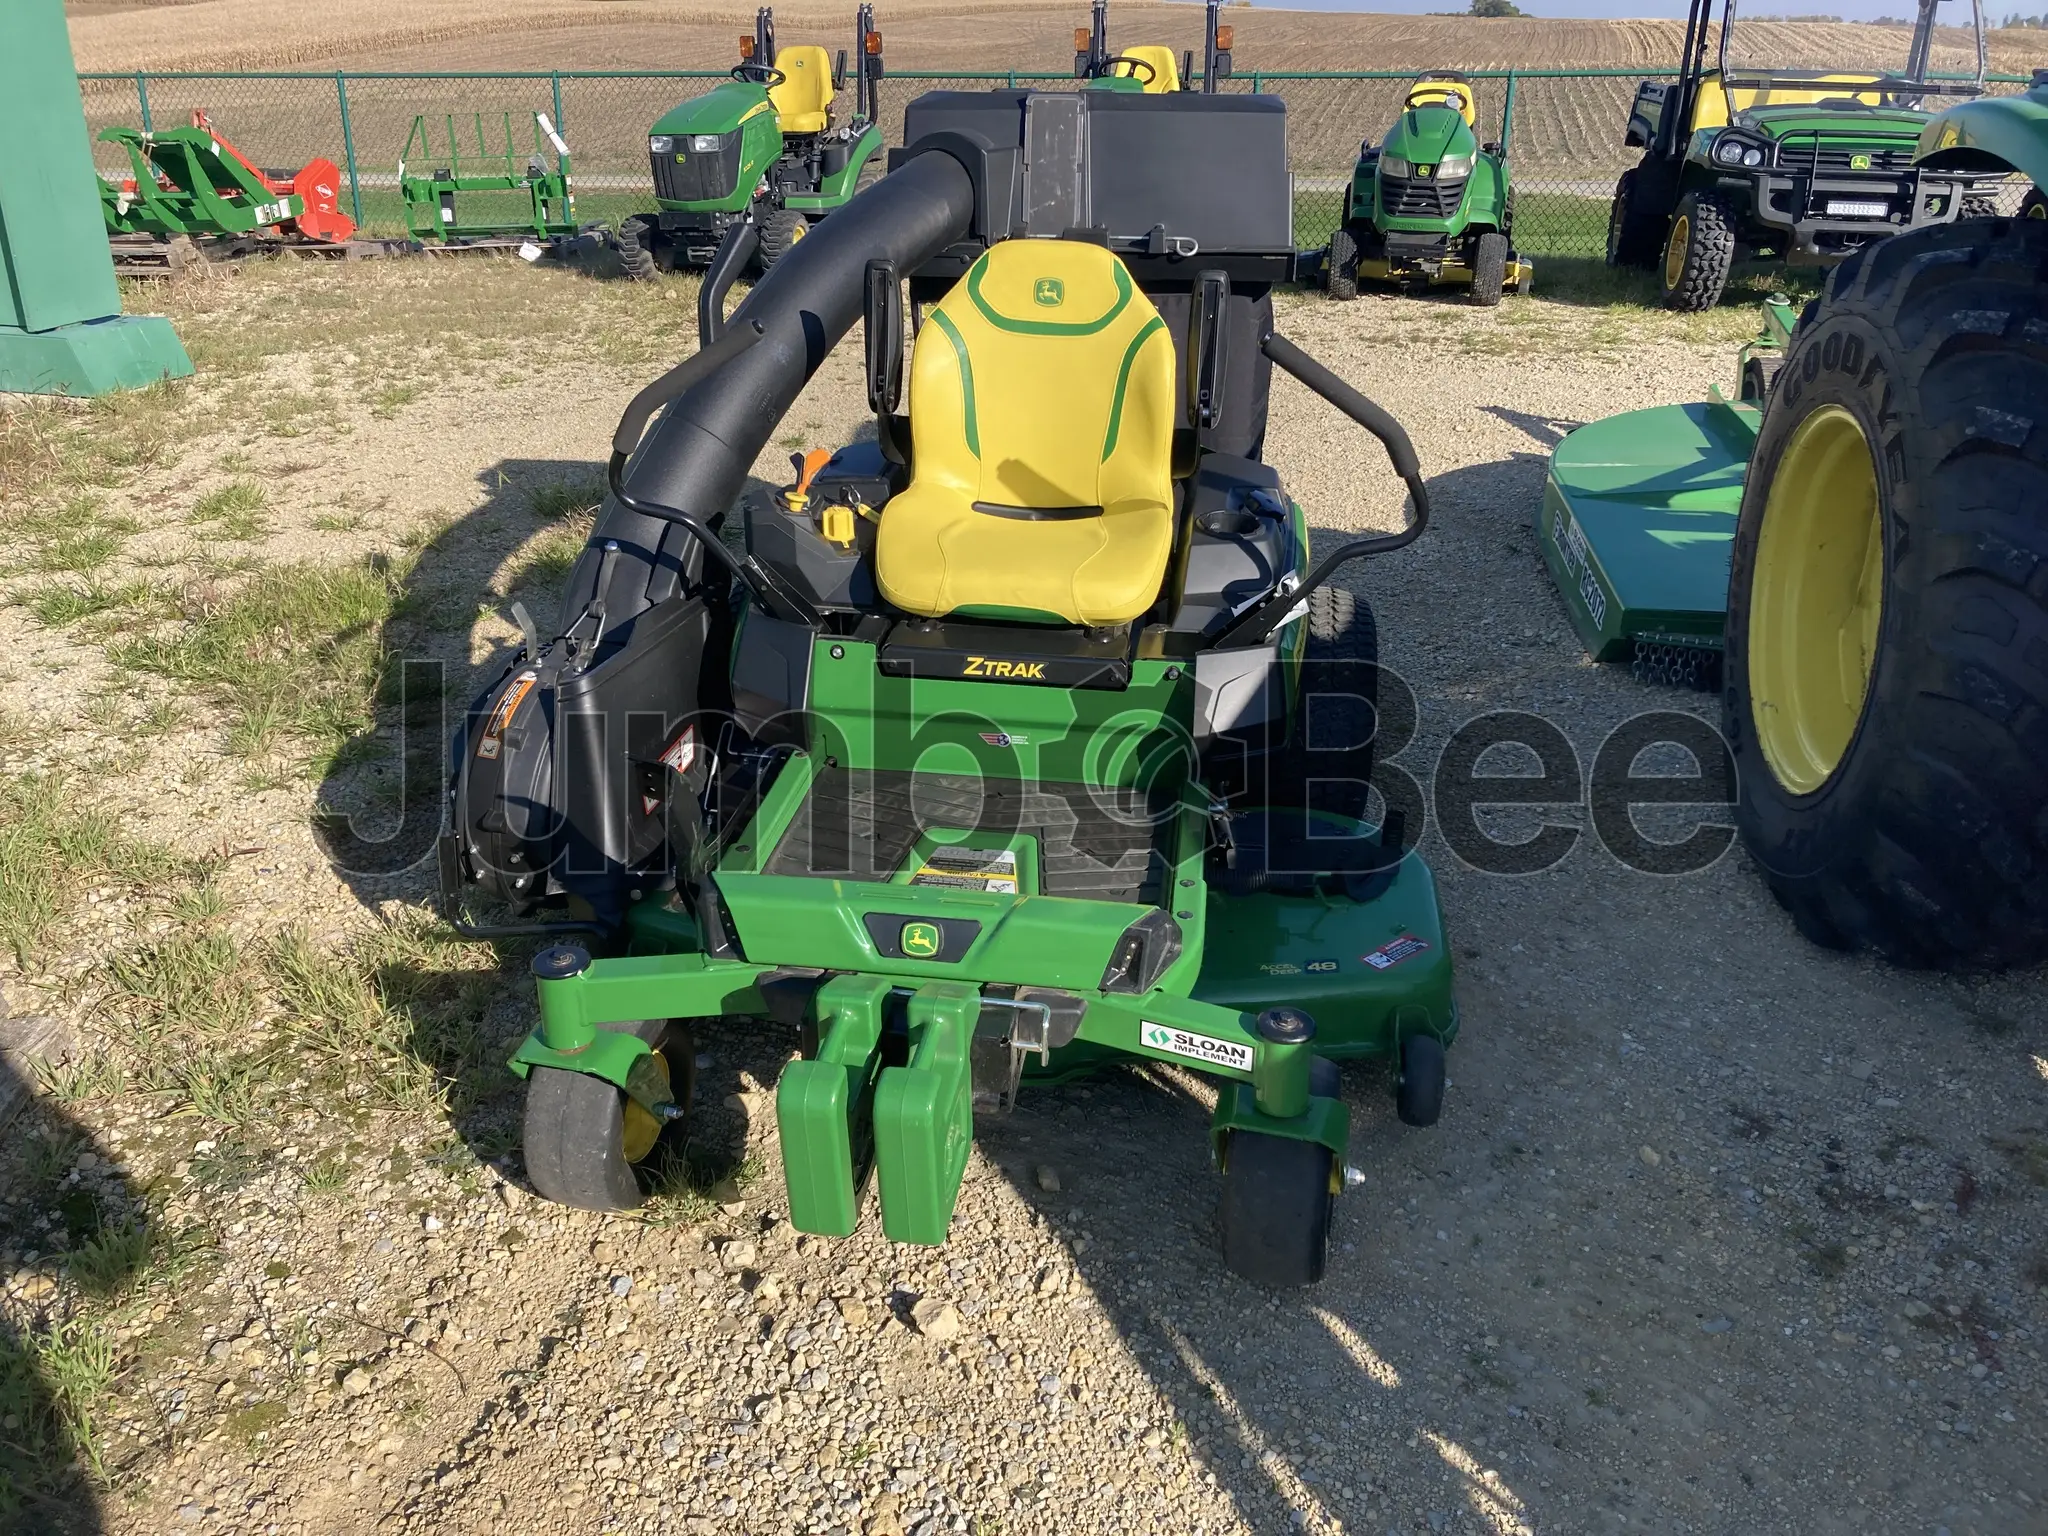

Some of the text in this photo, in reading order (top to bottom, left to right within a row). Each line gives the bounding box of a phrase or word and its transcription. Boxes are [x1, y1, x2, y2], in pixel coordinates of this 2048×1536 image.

[963, 656, 1046, 679] ZTRAK
[1307, 961, 1337, 972] 48
[1174, 1033, 1246, 1059] SLOAN
[1174, 1044, 1246, 1066] IMPLEMENT
